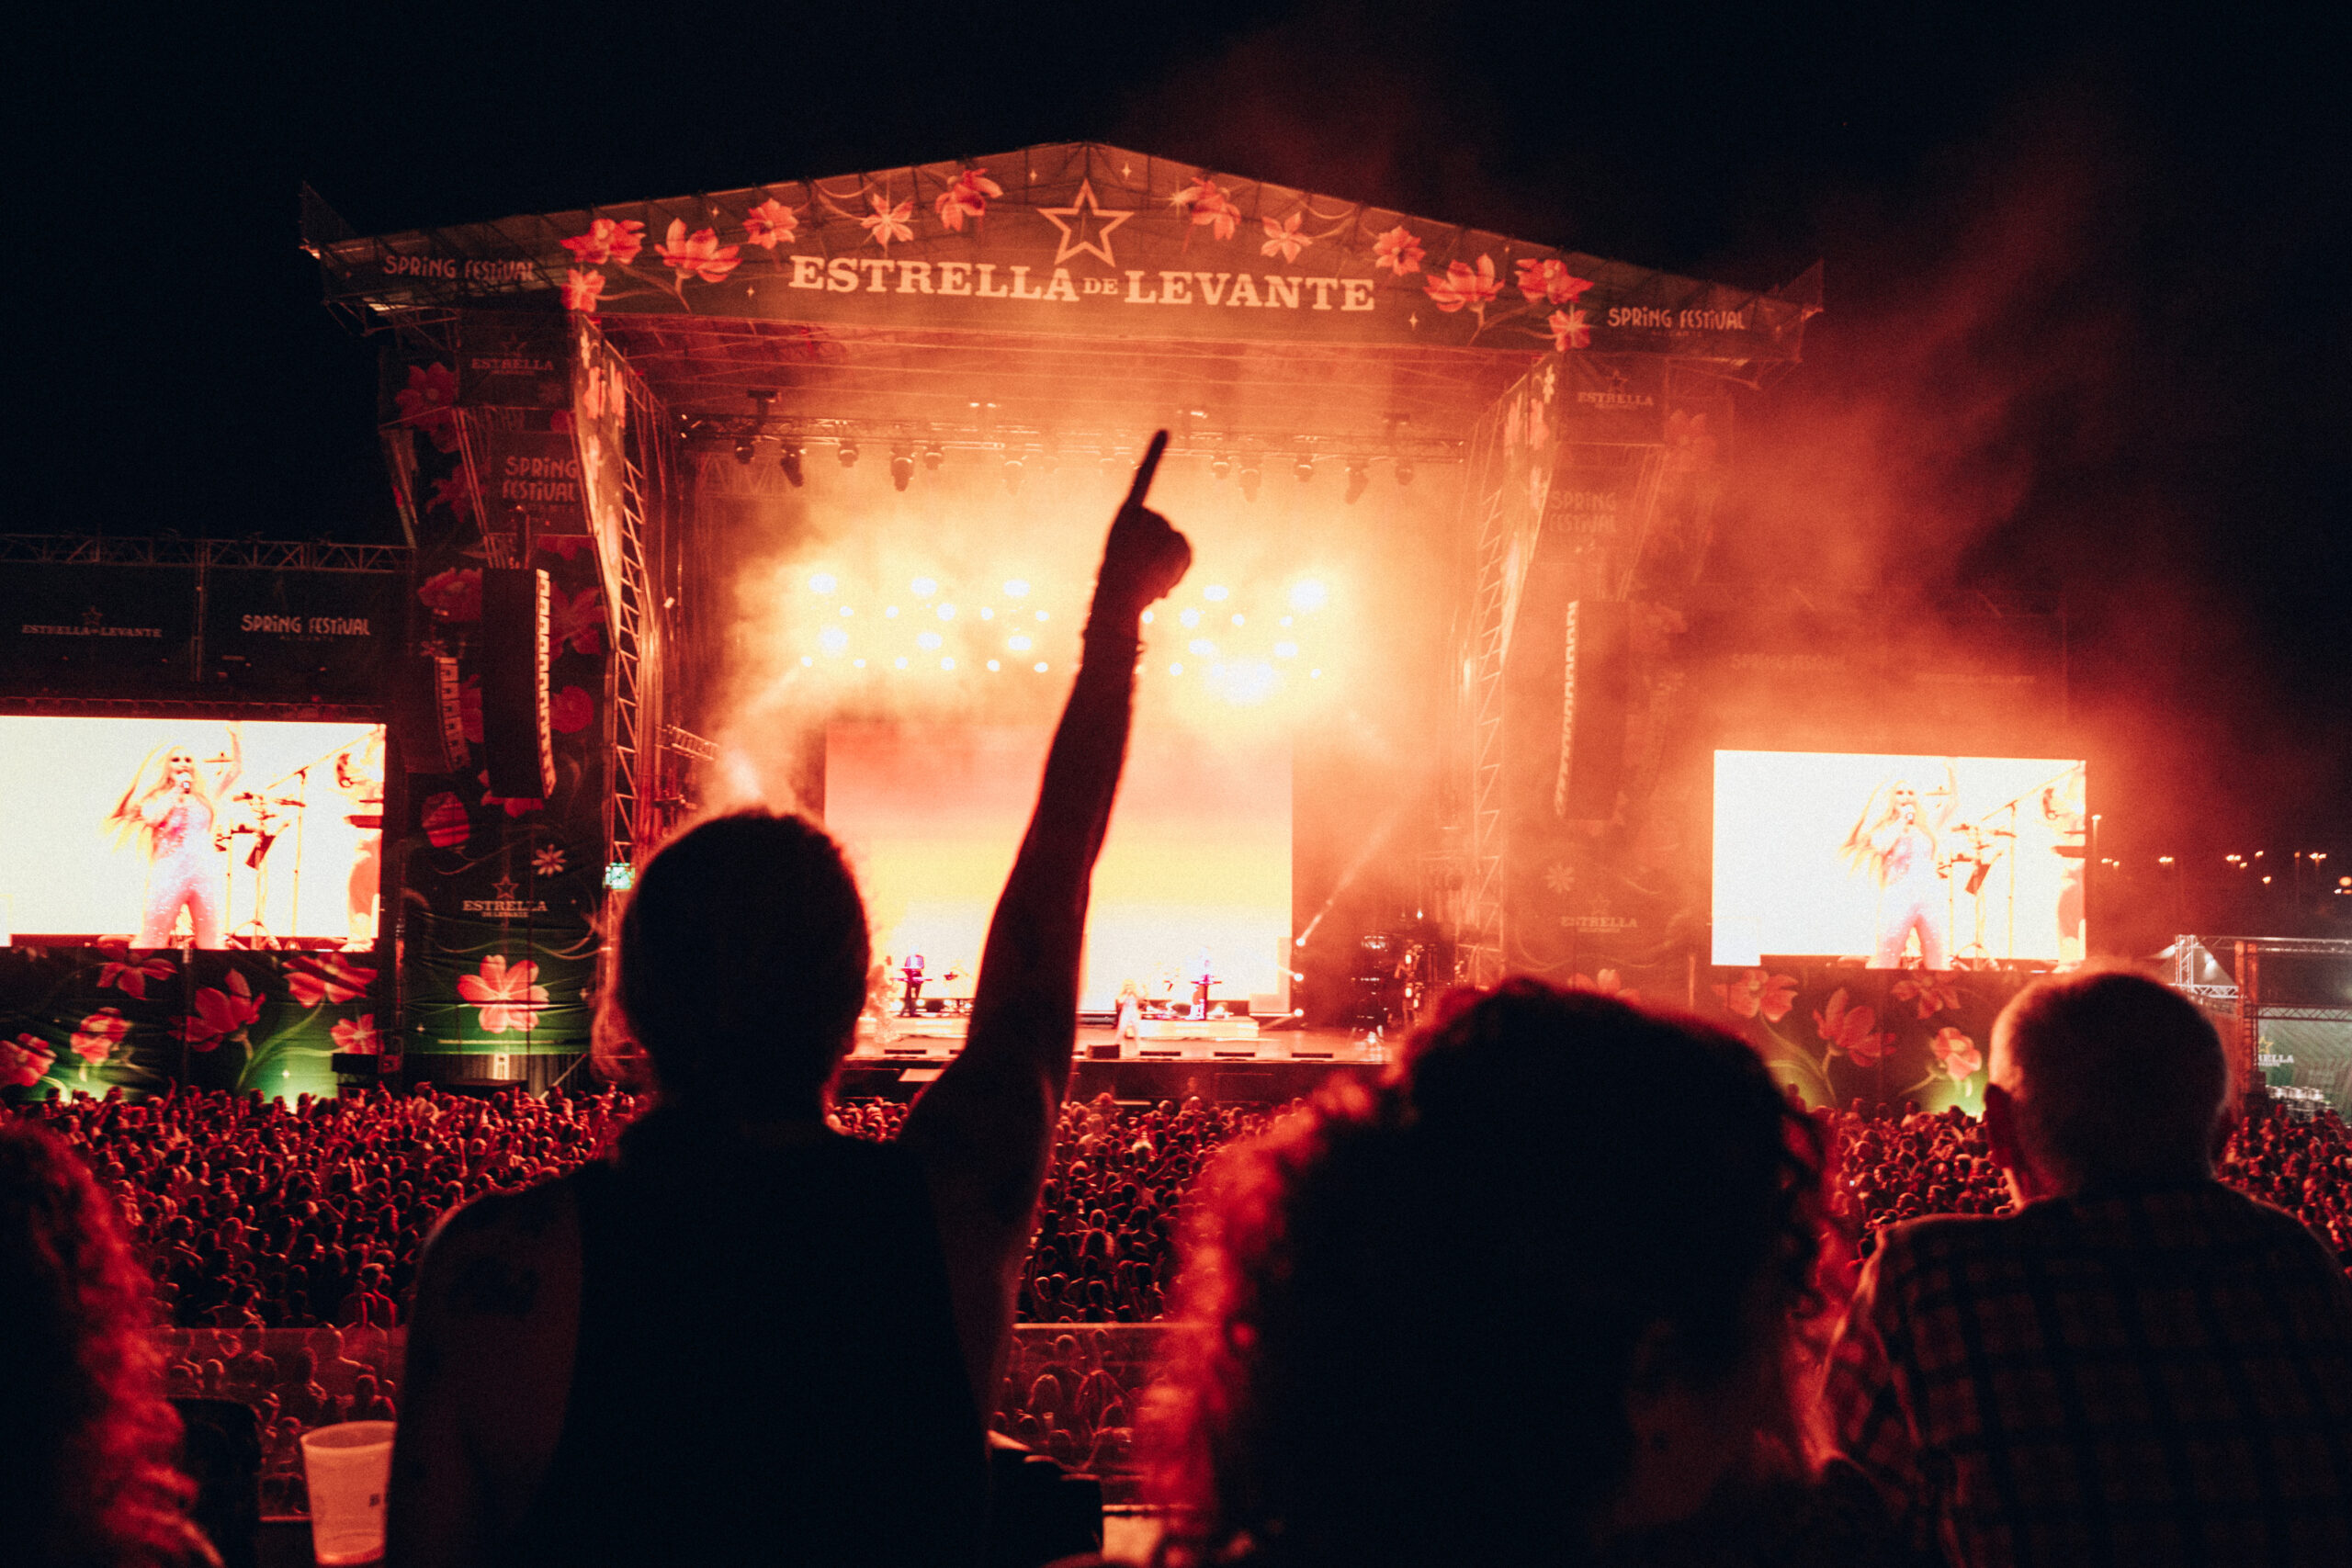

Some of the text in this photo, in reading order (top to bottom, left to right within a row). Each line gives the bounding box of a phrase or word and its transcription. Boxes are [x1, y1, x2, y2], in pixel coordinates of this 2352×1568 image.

[788, 254, 1375, 311] ESTRELLA DE LEVANTE
